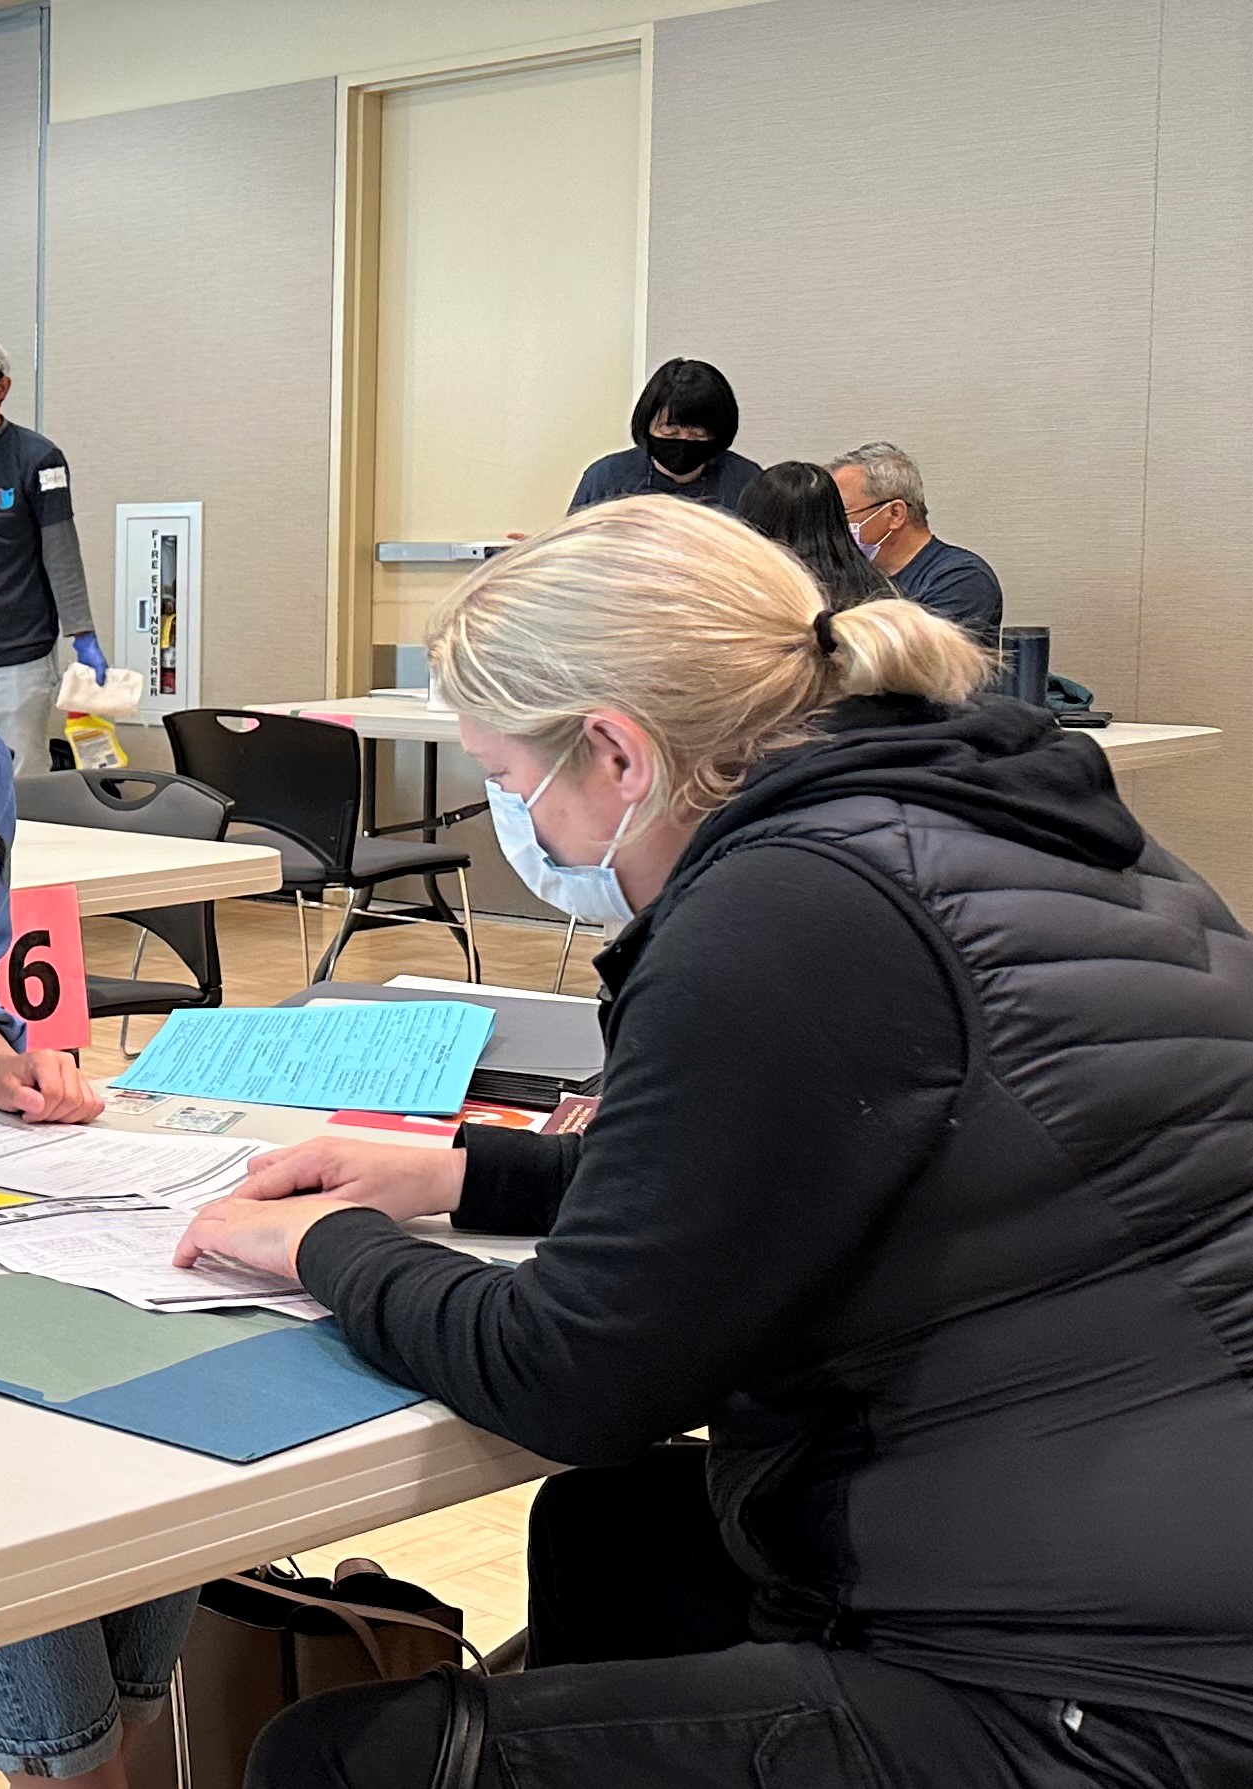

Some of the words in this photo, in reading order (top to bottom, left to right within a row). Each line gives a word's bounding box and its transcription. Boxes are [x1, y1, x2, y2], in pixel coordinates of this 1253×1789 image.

[151, 529, 159, 570] FIRE
[150, 575, 159, 697] EXTINGUISHER
[7, 930, 60, 1021] 6
